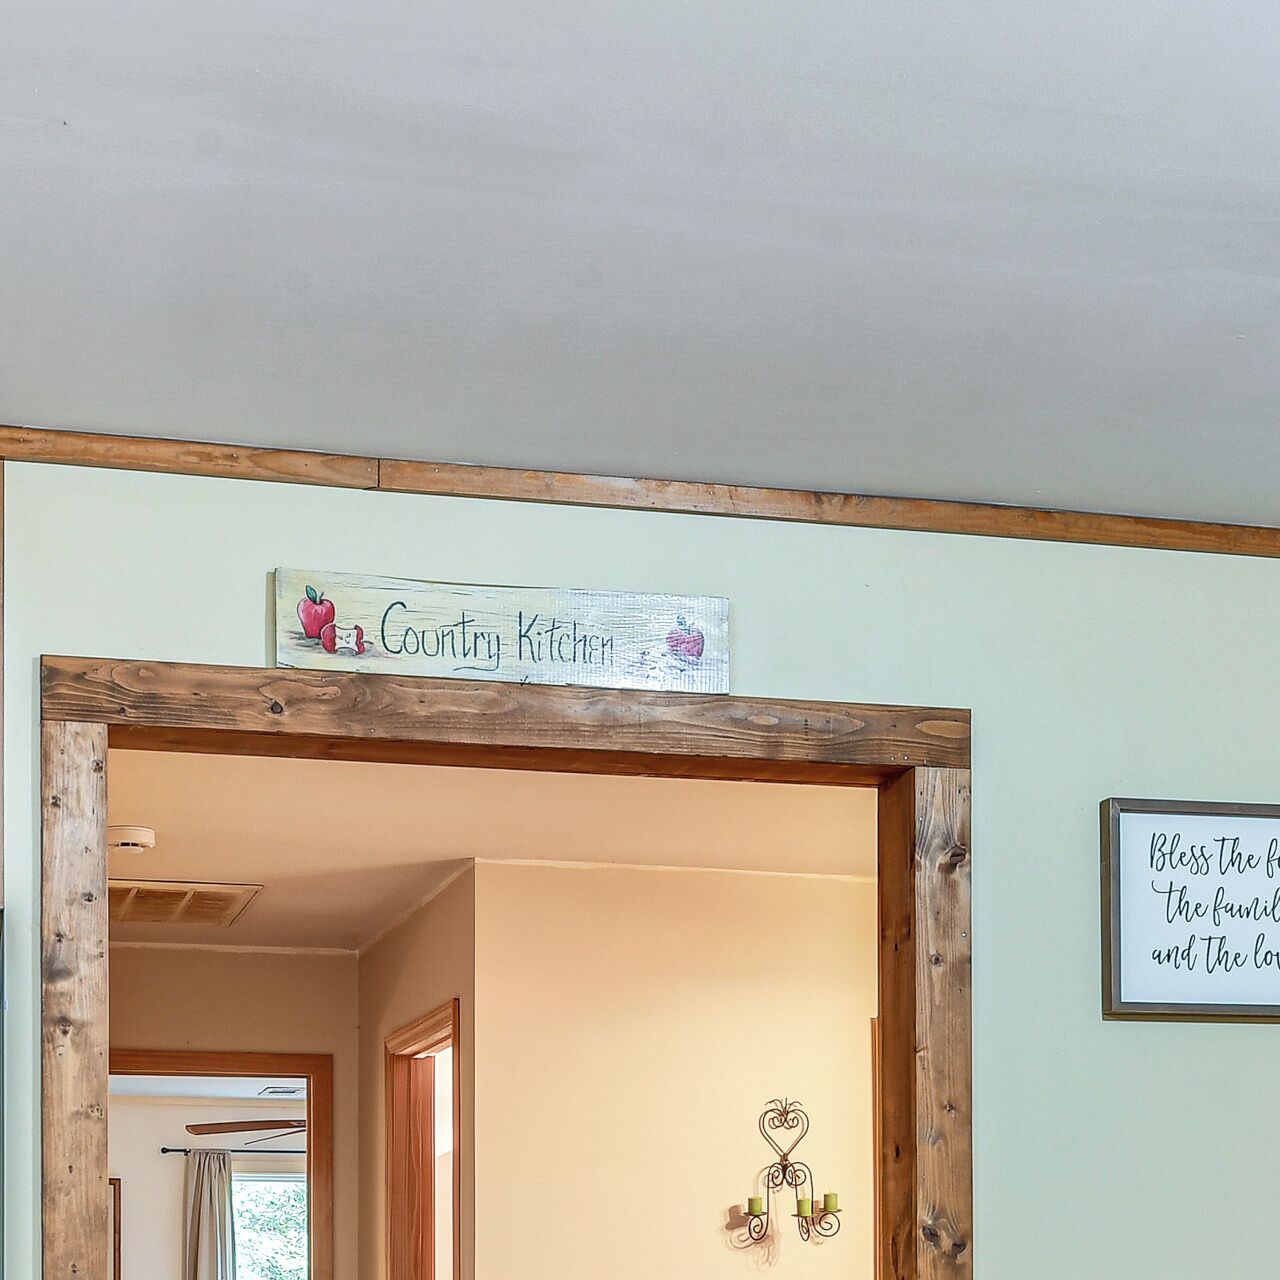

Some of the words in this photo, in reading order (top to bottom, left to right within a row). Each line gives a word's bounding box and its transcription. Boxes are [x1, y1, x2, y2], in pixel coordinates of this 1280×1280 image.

[381, 601, 500, 672] Country
[517, 610, 614, 666] Kitchen
[1150, 833, 1213, 876] Bless
[1151, 880, 1208, 924] the
[1152, 934, 1196, 971] and
